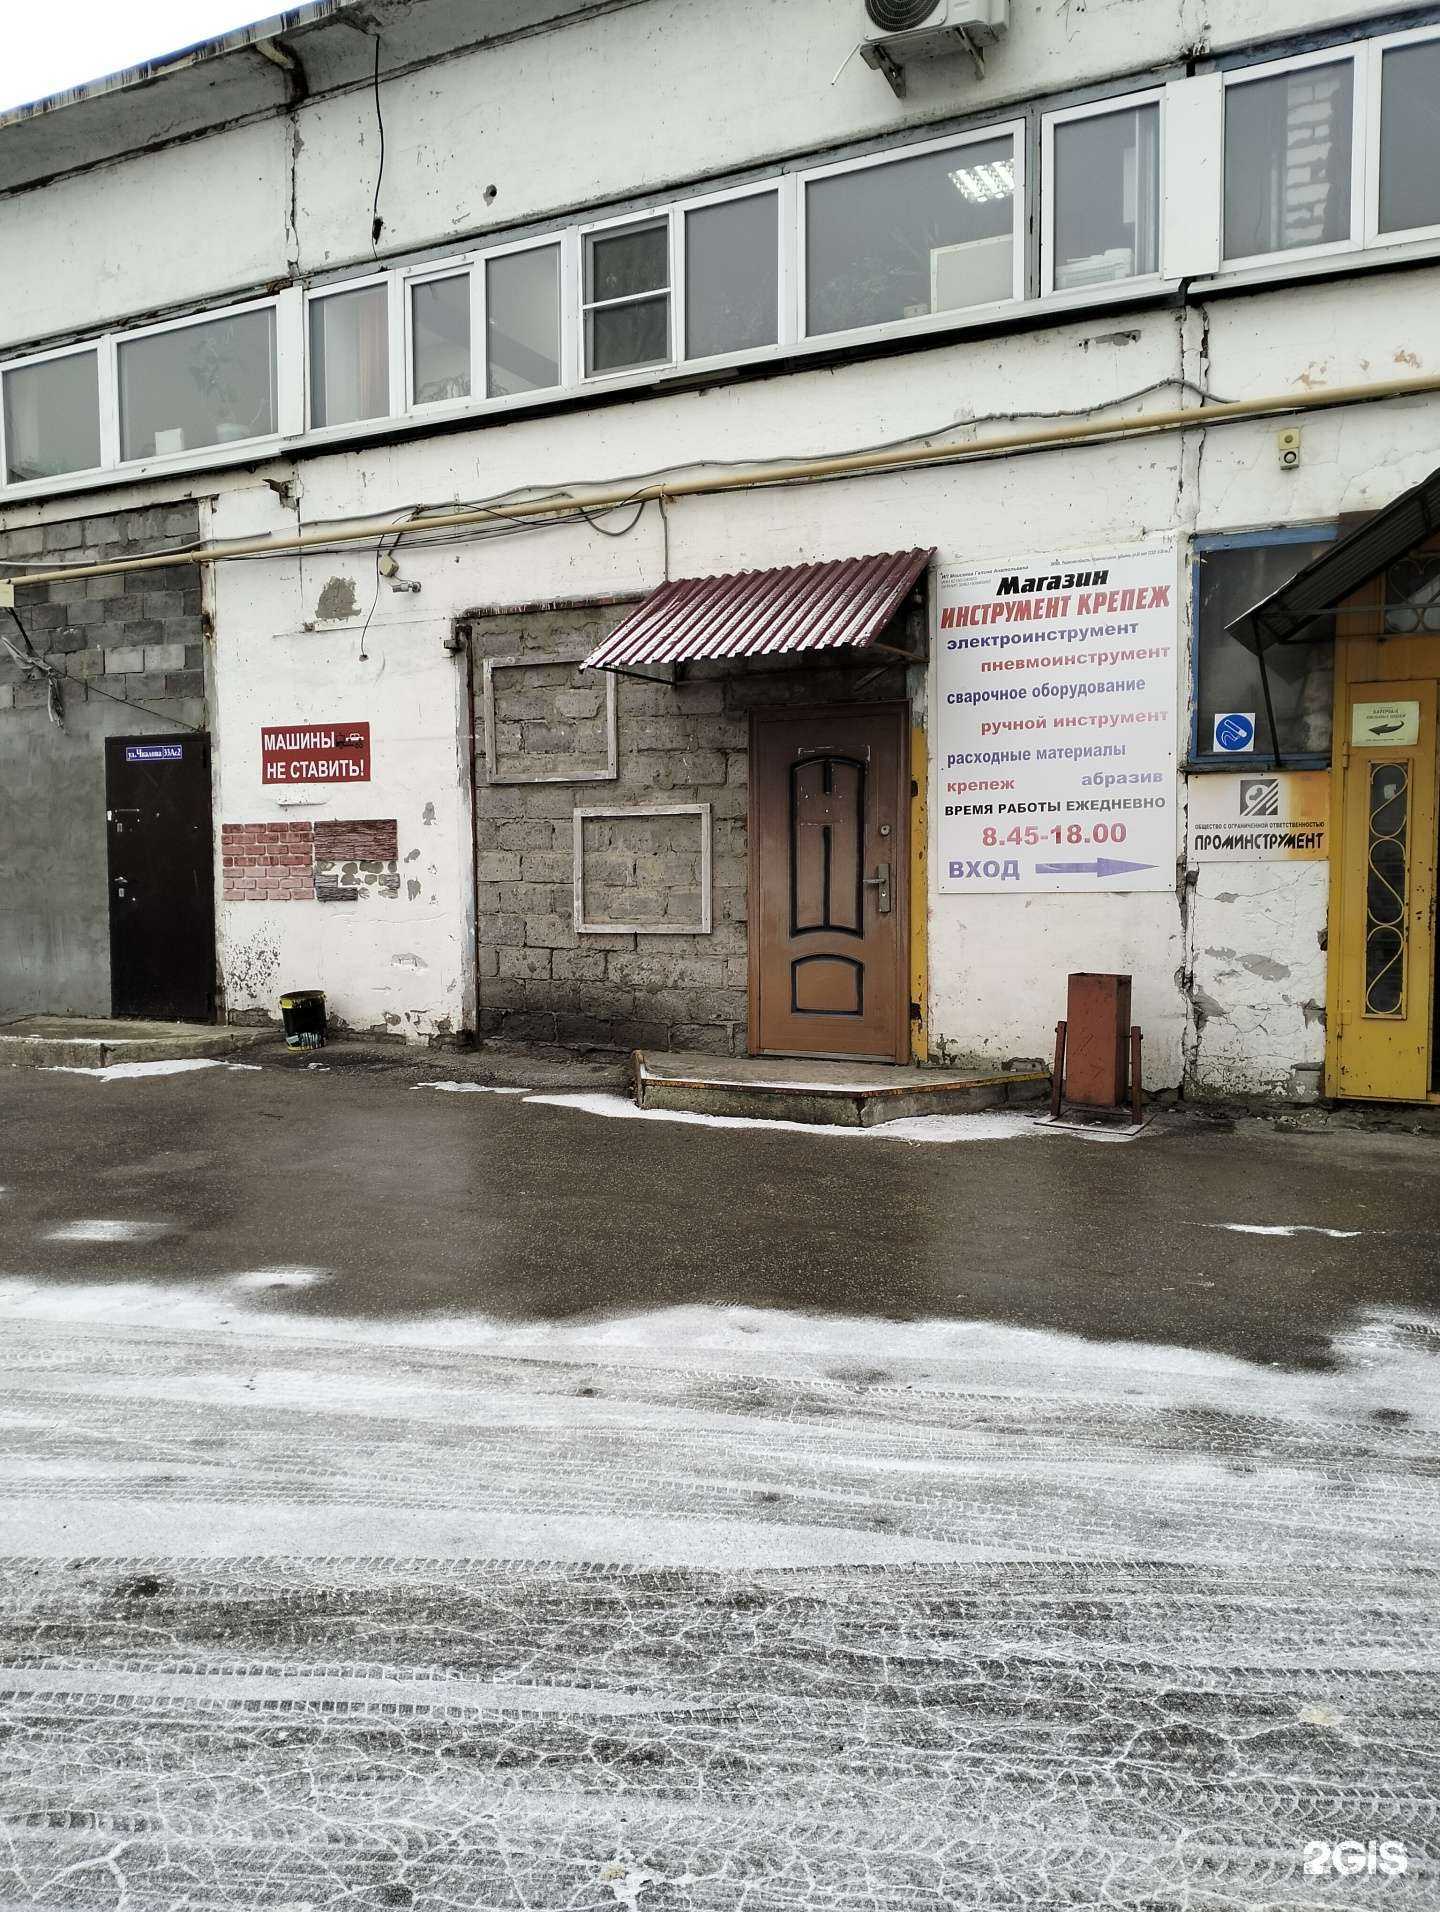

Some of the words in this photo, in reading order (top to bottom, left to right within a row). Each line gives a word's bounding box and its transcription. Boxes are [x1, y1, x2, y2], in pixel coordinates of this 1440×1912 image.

[996, 569, 1109, 596] Магазин
[940, 595, 1072, 629] ИНСТРУМЕНТ
[1077, 585, 1171, 616] КРЕПЕЖ
[946, 622, 1139, 650] электроинструмент
[981, 646, 1171, 673] пневмоинструмент
[947, 686, 1027, 706] сварочное
[1031, 677, 1146, 700] оборудование
[981, 716, 1047, 736] ручной
[1053, 710, 1169, 729] инструмент
[264, 731, 335, 751] МАШИНЫ
[947, 748, 1031, 768] расходные
[1036, 743, 1126, 762] материалы
[267, 762, 286, 779] НЕ
[290, 759, 364, 779] СТАВИТЬ!
[1081, 771, 1163, 788] абразив
[947, 778, 1015, 795] крепеж
[945, 803, 993, 816] ВРЕМЯ
[998, 801, 1061, 814] РАБОТЫ
[1066, 797, 1166, 812] ЕЖЕДНЕВНО
[982, 822, 1127, 847] 8.45-18.00
[1269, 821, 1325, 829] ОТВЕТСТВЕННОСТЬЮ
[1194, 833, 1325, 850] ПРОМИНСТРУМЕНТ
[949, 859, 1021, 881] ВХОД
